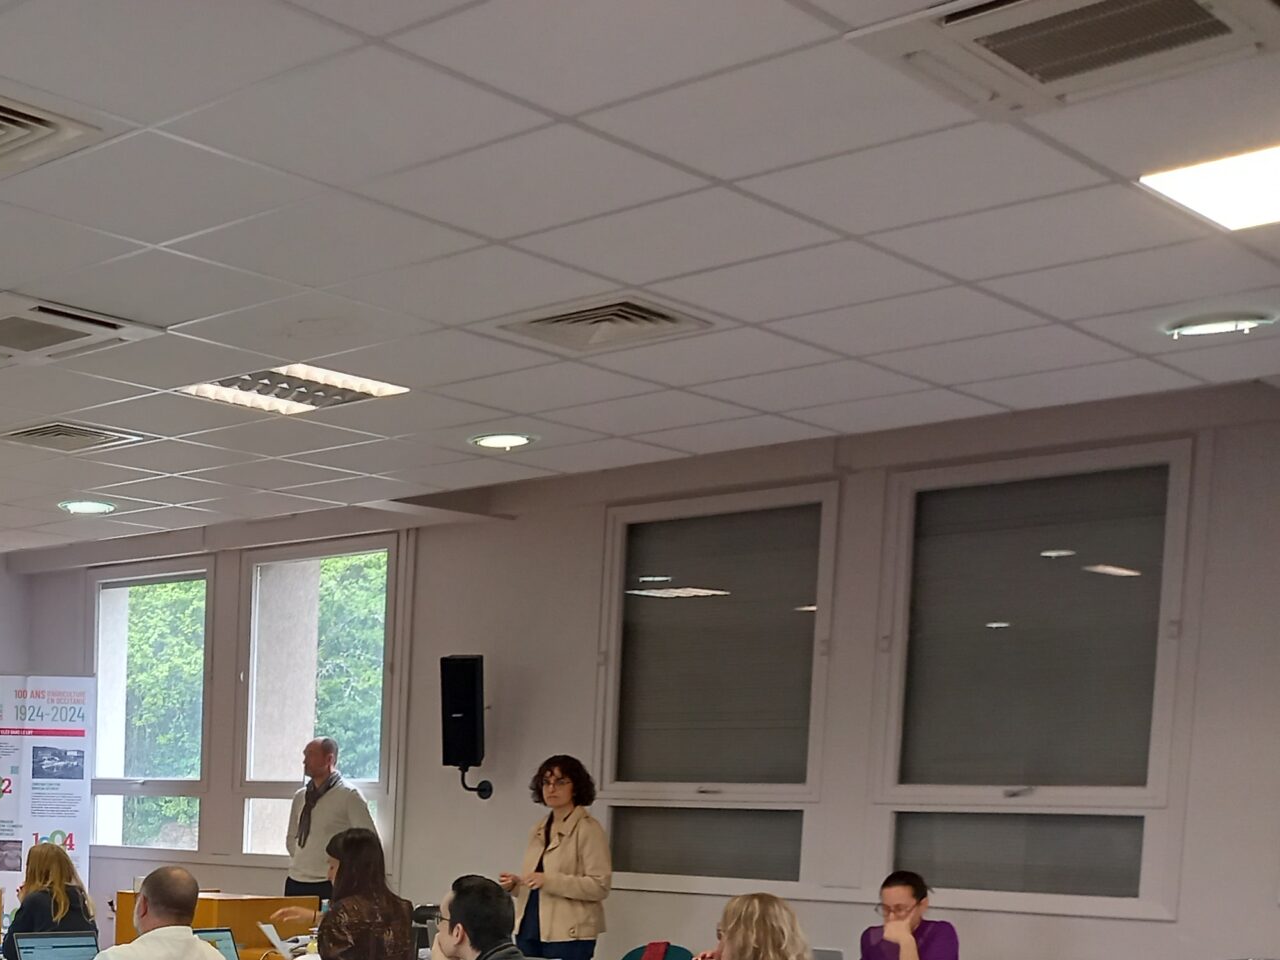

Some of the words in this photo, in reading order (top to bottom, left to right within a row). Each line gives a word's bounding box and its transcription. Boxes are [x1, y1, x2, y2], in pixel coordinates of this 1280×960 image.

[14, 689, 28, 699] 100
[30, 690, 46, 700] ANS
[14, 705, 85, 722] 1924-2024
